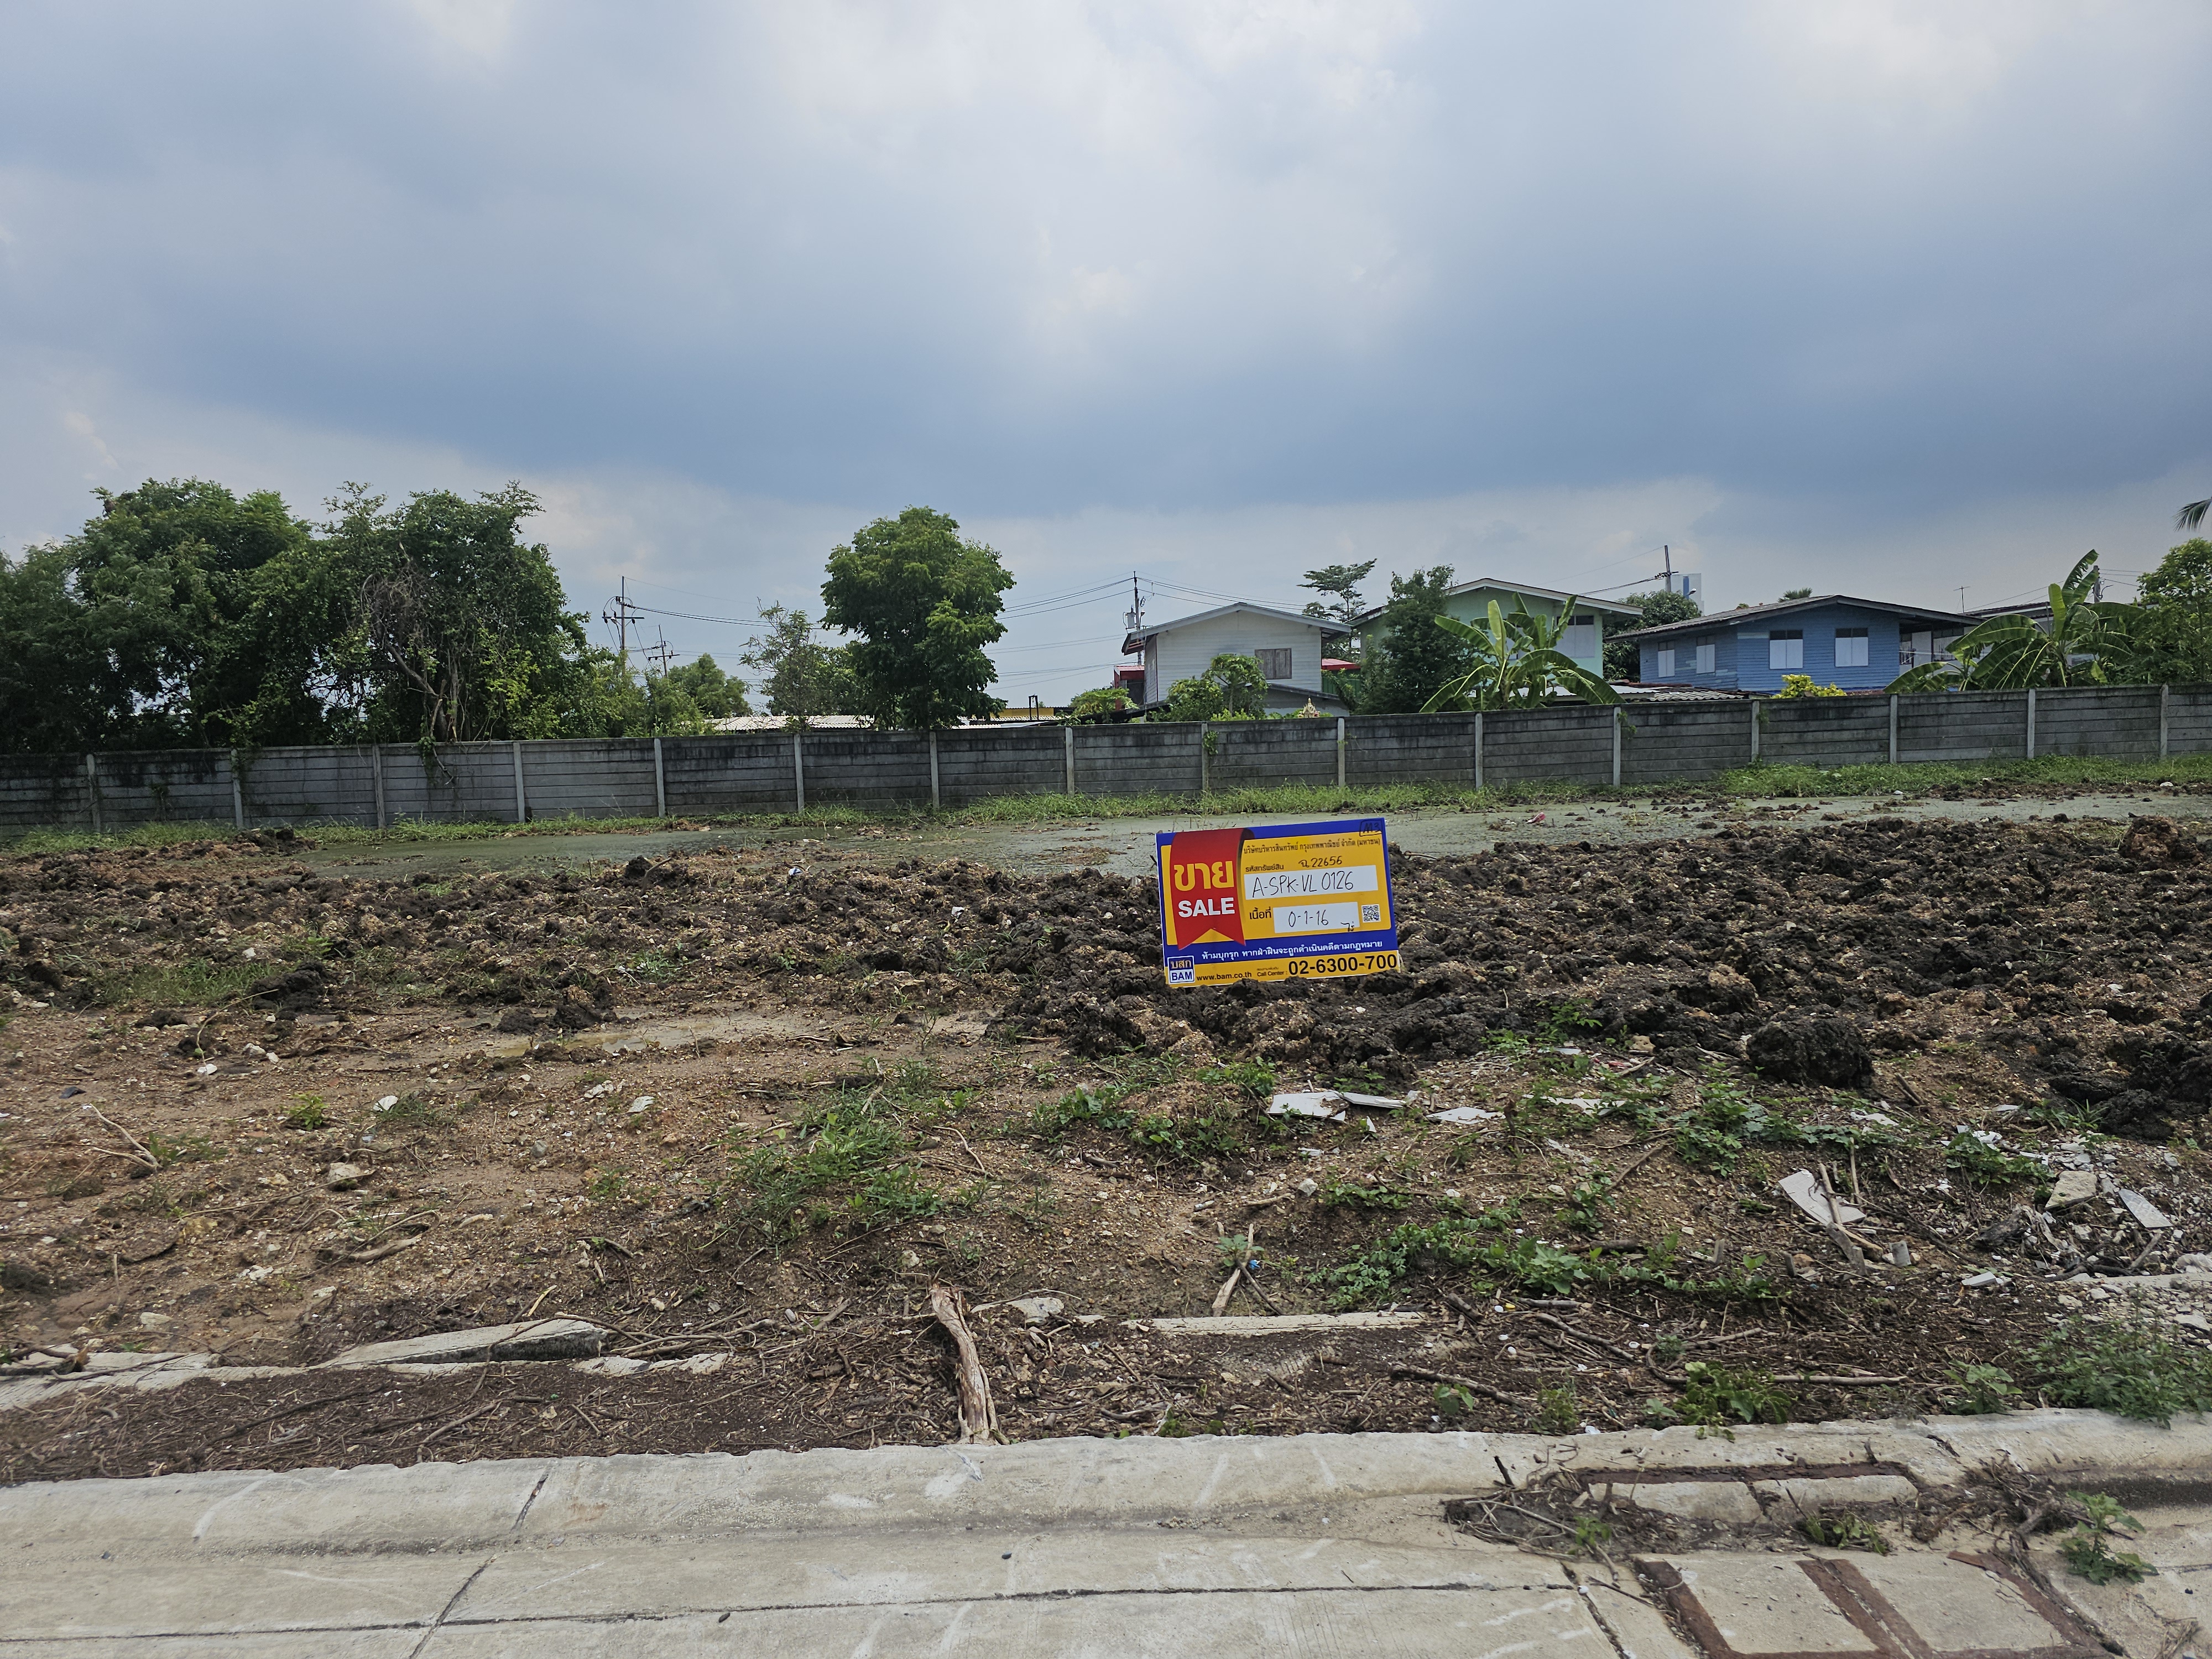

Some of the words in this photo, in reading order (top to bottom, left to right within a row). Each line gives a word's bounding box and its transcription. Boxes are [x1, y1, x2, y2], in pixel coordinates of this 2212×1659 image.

[1243, 841, 1298, 854] บริษัทบริหารสินทรัพย์
[1299, 838, 1340, 852] กรุงเทพพาณิชย์
[1340, 838, 1356, 847] จำกัด
[1357, 838, 1380, 847] (มหาชน)
[1173, 860, 1235, 891] ขาย
[1245, 864, 1284, 873] รหัสทรัพย์สิน
[1178, 898, 1235, 918] SALE
[1249, 906, 1272, 920] เนื้อที่
[1288, 910, 1328, 927] 0-1-16
[1201, 951, 1239, 961] ห้ามบุกรุก
[1242, 941, 1383, 957] หากฝ่าฝืนจะถูกดำเนินคดีตามกฎหมาย
[1170, 959, 1192, 969] บสก
[1288, 954, 1397, 975] 02-6300-700
[1171, 972, 1193, 981] BAM
[1196, 972, 1252, 982] www.bam.co.th
